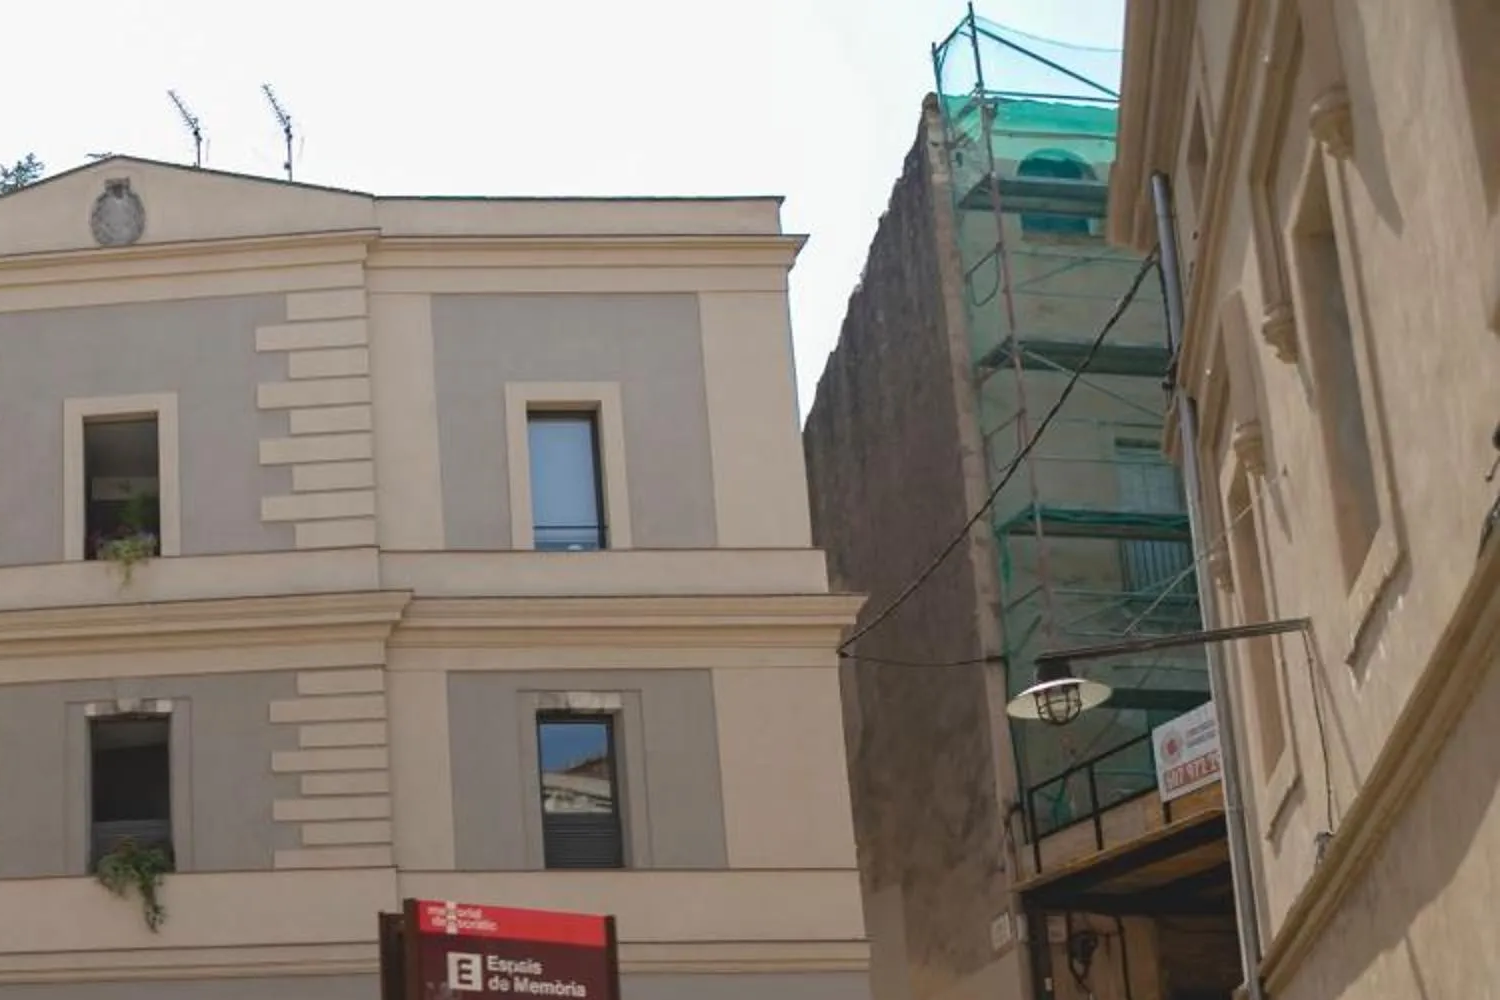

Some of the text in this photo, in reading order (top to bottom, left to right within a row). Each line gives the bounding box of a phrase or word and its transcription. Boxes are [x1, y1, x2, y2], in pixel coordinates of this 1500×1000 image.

[457, 959, 473, 985] E
[487, 955, 542, 977] Espais
[488, 975, 586, 997] de Memòria
